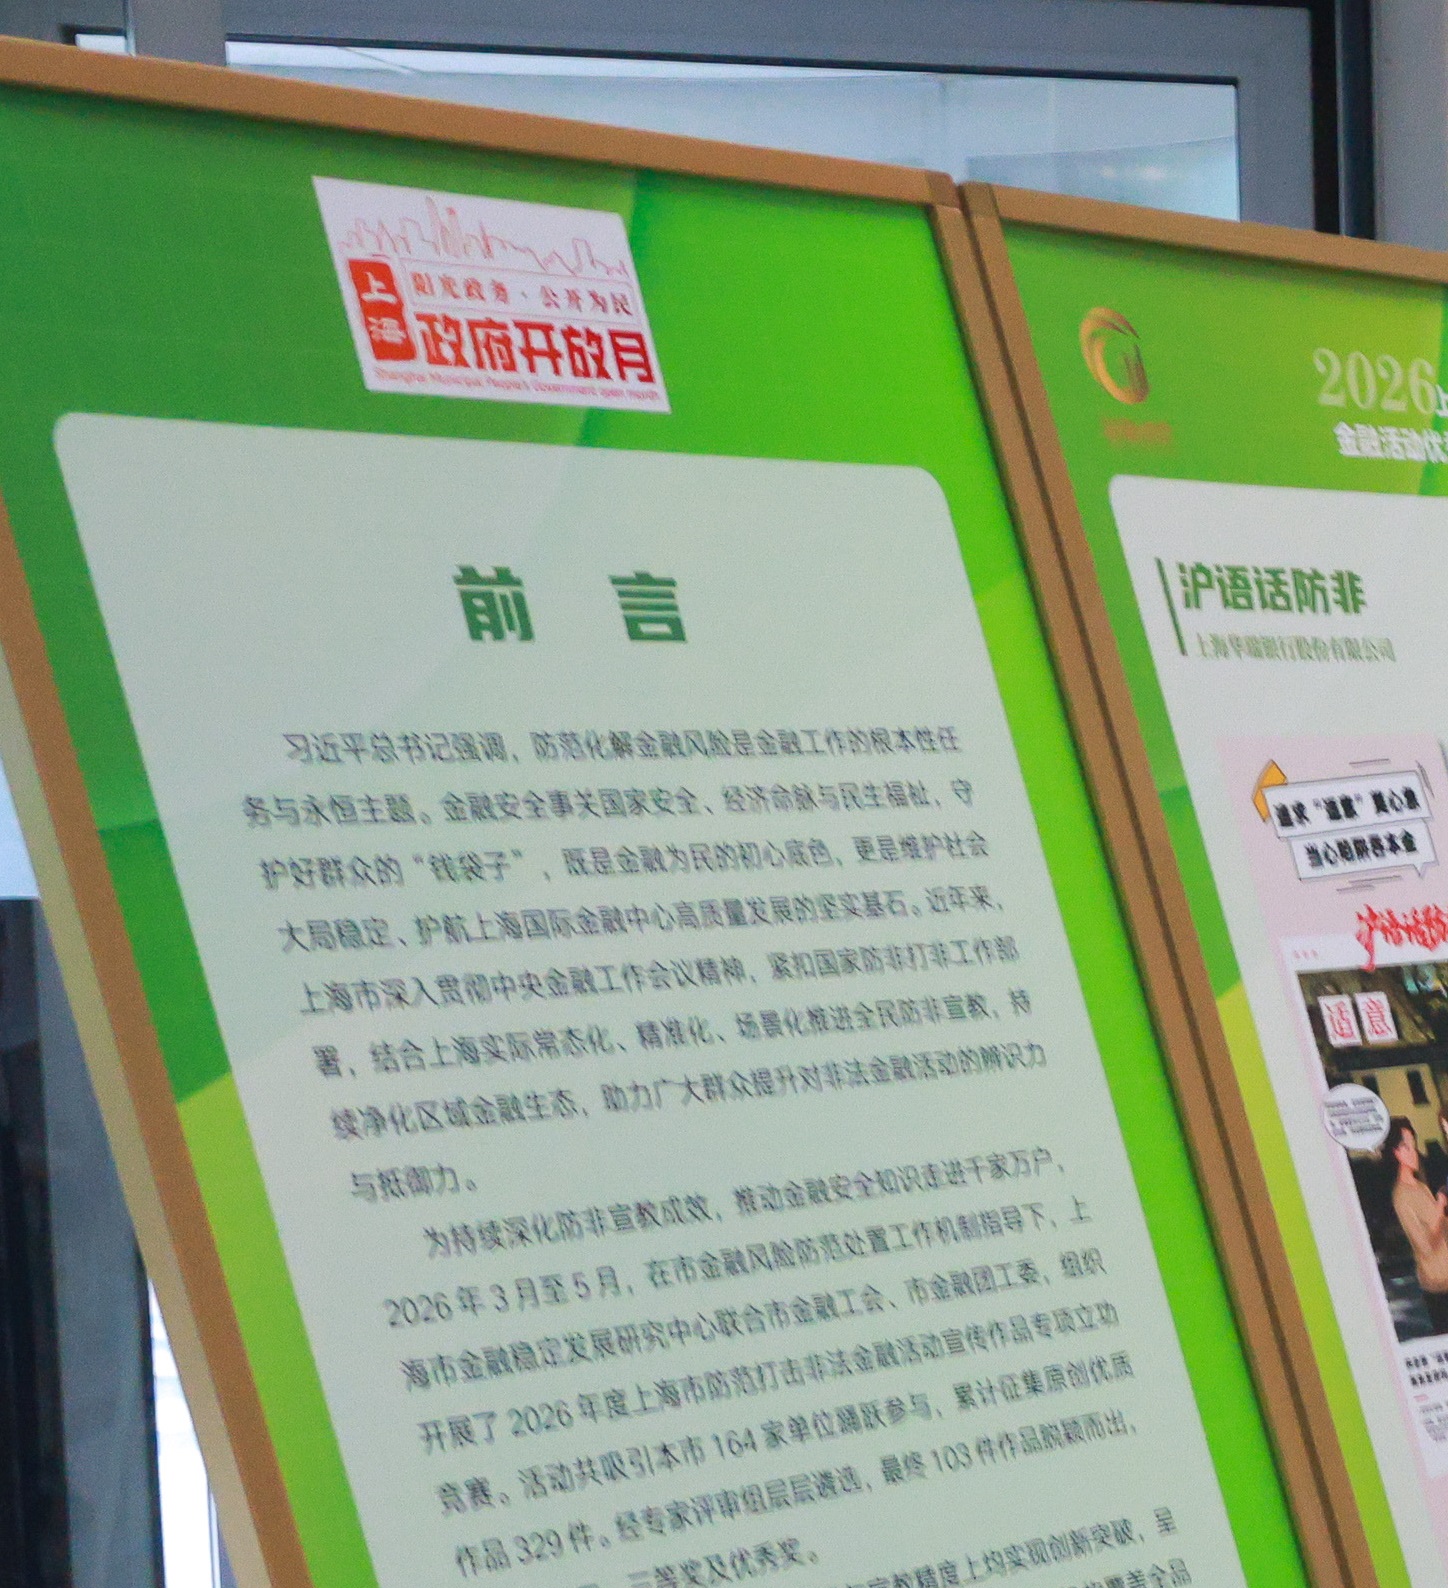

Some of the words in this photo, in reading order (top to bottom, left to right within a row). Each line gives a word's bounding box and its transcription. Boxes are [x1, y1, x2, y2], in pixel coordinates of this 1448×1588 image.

[414, 311, 656, 385] 政府开放月
[452, 564, 689, 644] 前言
[1170, 559, 1372, 618] 沪语话防非
[349, 1162, 478, 1203] 与抵御力。
